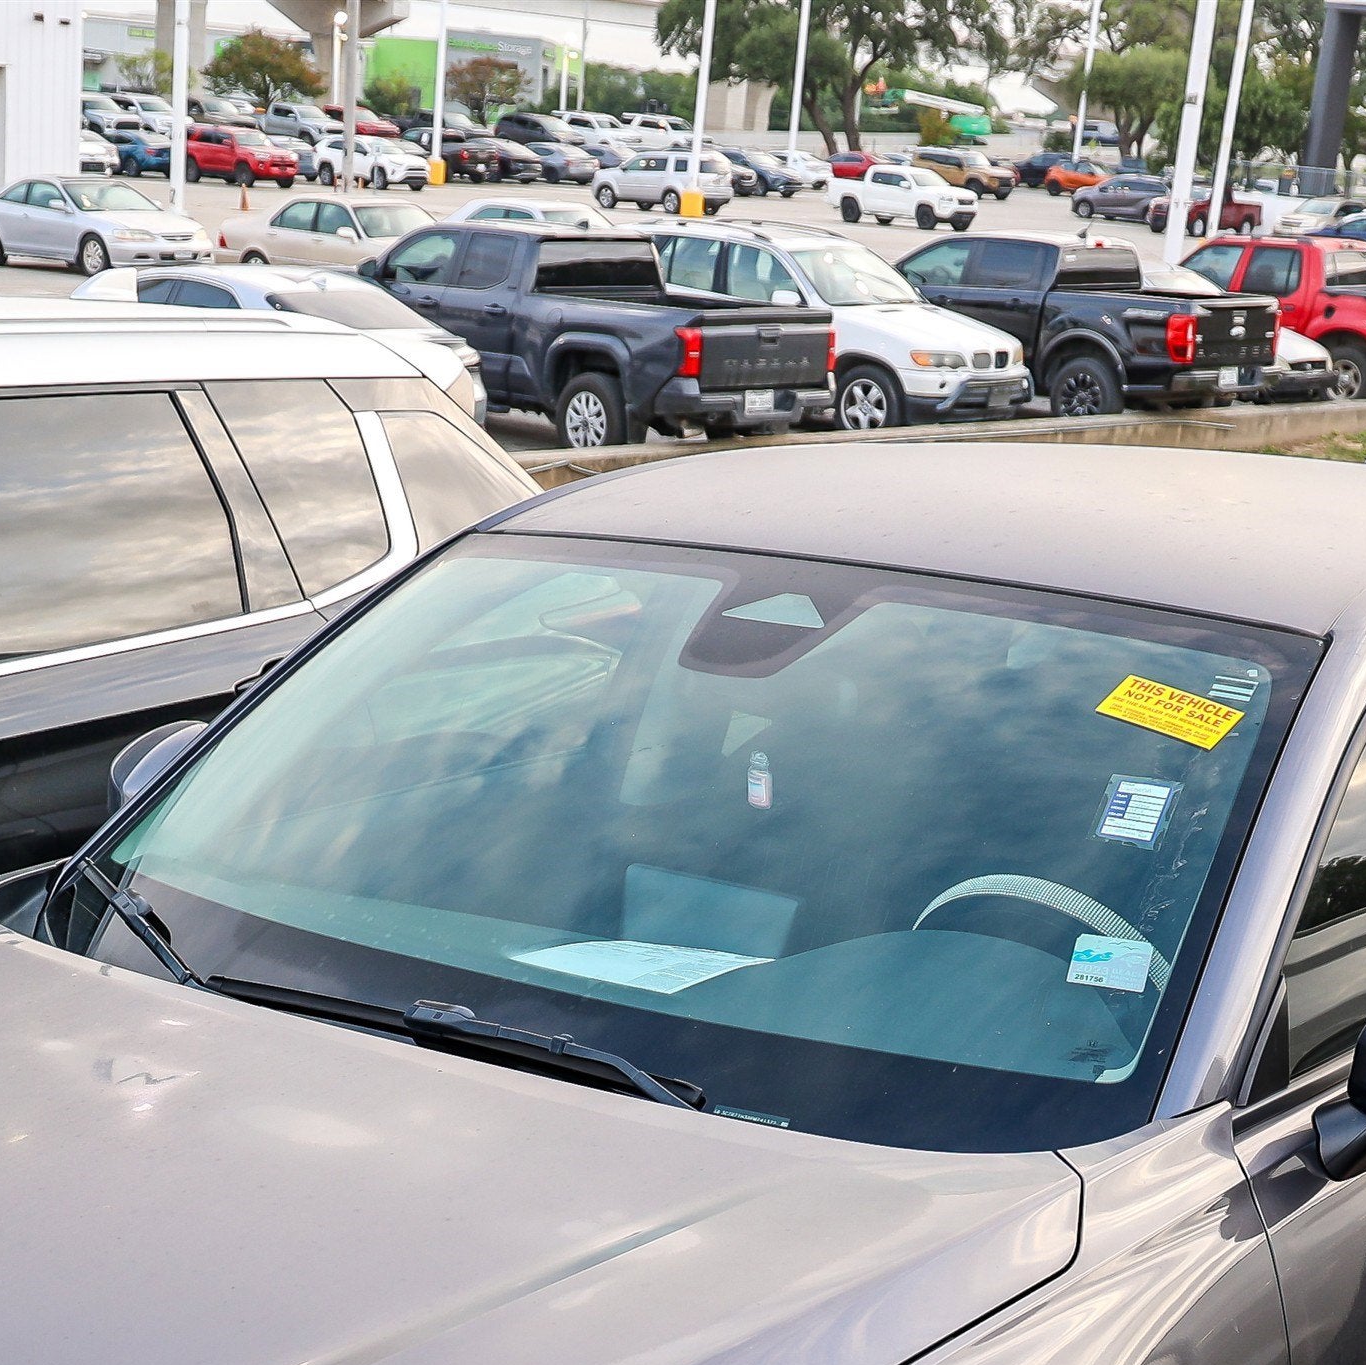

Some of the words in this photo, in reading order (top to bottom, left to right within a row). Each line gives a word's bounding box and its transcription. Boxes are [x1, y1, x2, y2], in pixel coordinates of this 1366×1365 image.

[498, 41, 532, 56] Storage
[1124, 690, 1153, 702] NOT
[1154, 699, 1185, 713] FOR
[1185, 710, 1225, 728] SALE
[1128, 679, 1167, 696] THIS
[1168, 691, 1237, 721] VEHICLE
